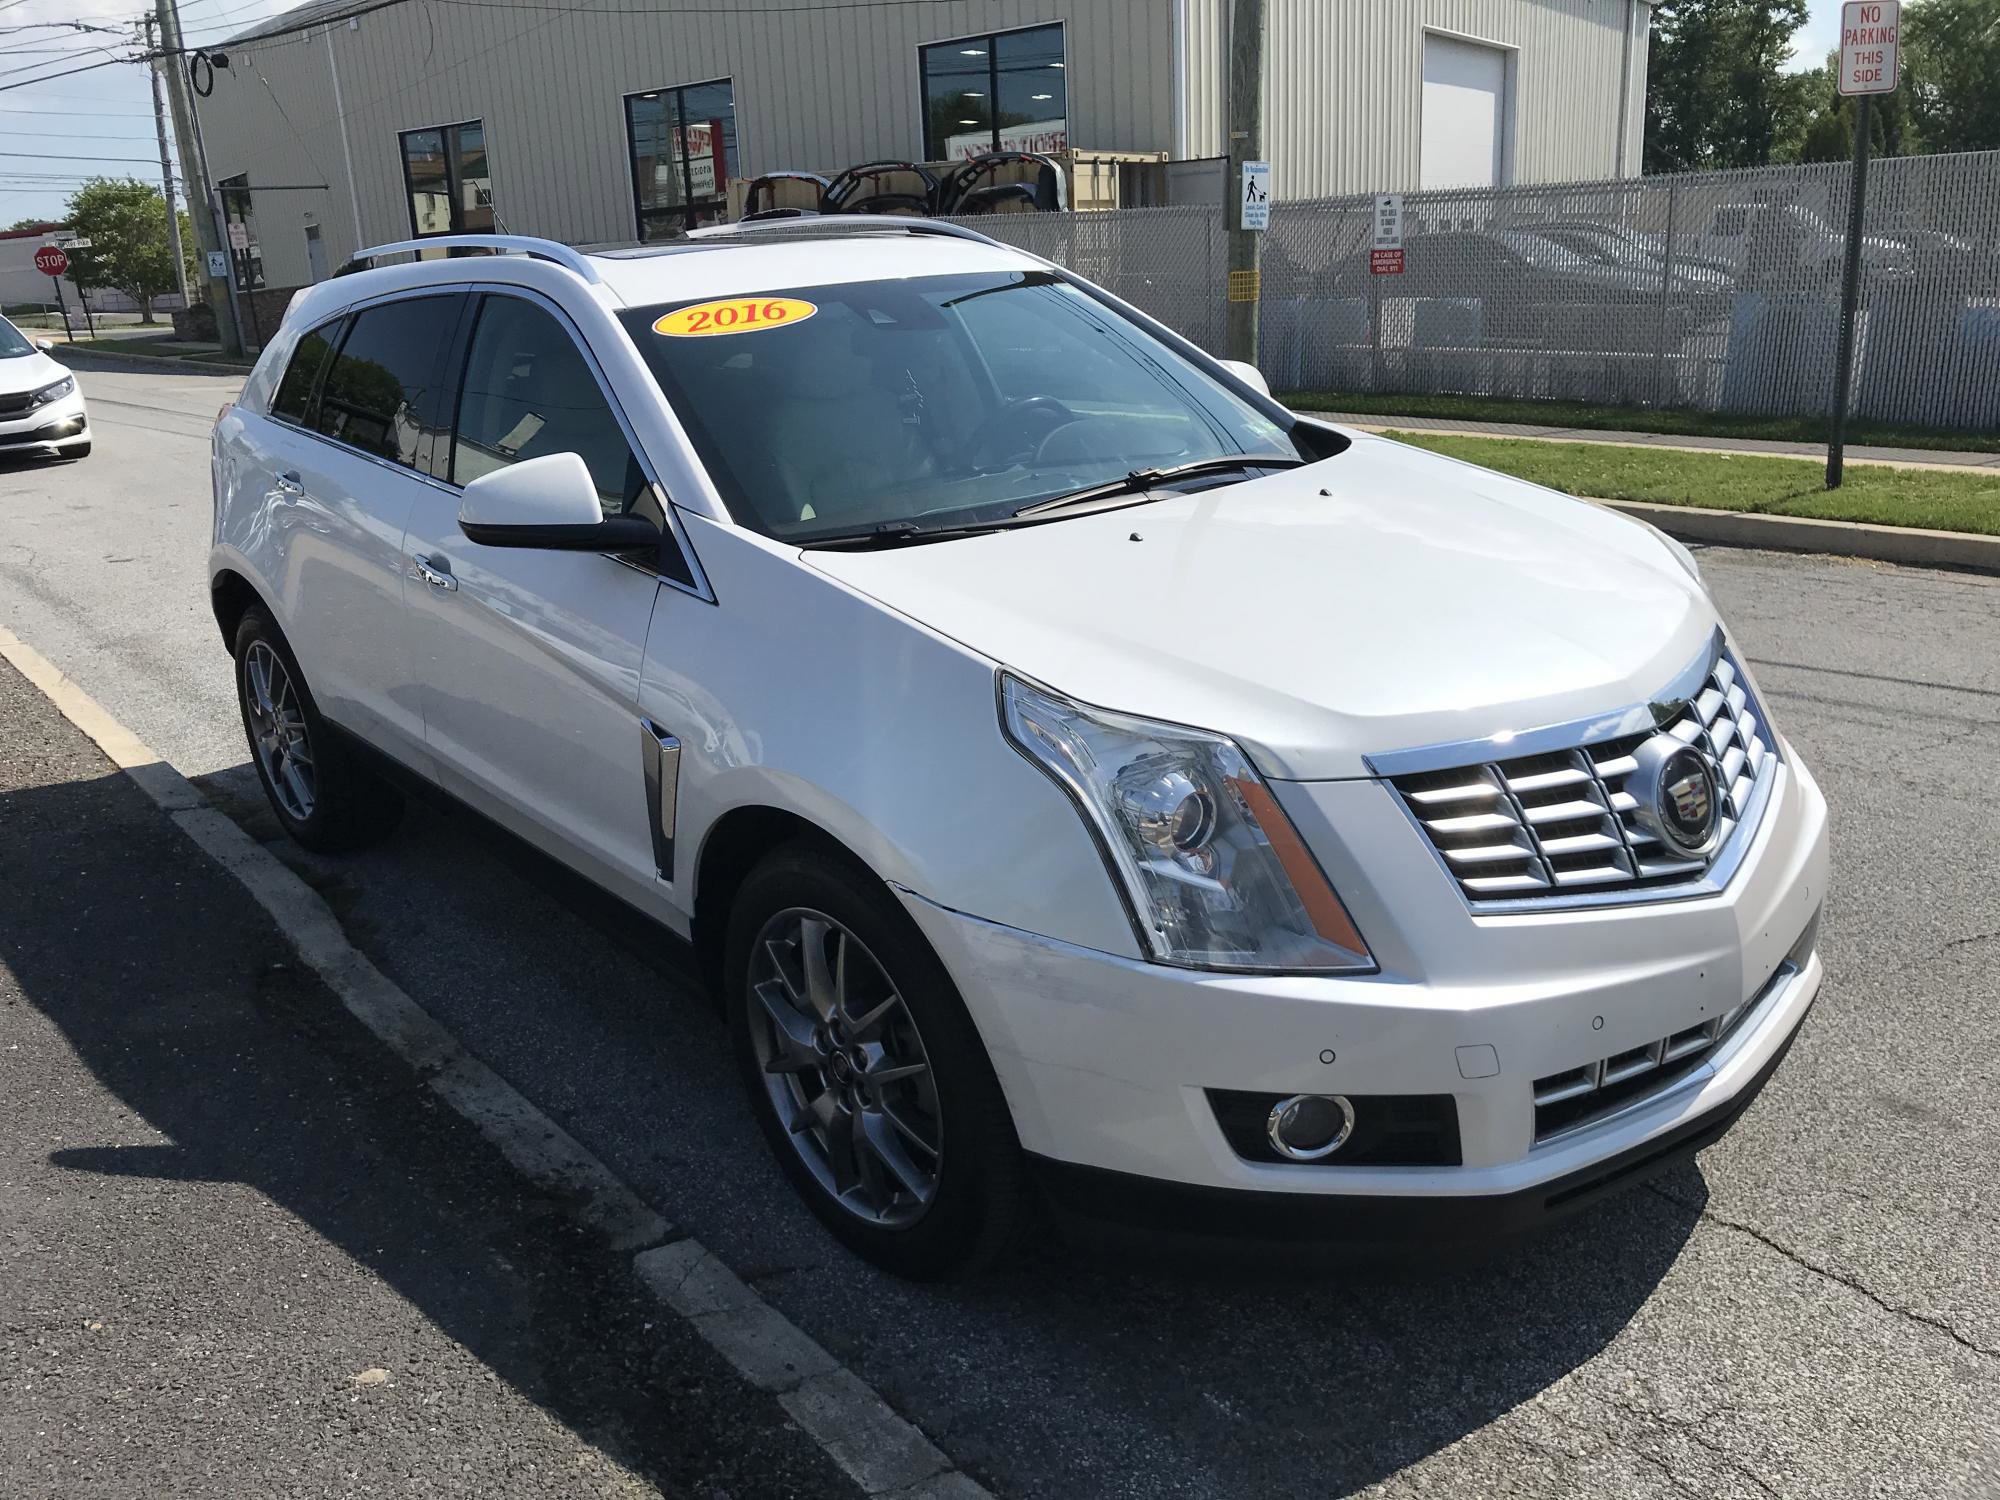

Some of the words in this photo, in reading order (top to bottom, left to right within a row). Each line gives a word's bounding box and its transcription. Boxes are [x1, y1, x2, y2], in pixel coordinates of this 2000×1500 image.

[1860, 6, 1881, 24] NO
[1844, 26, 1895, 46] PARKING
[1854, 51, 1884, 65] THIS
[1853, 68, 1883, 83] SIDE
[36, 254, 65, 268] STOP
[687, 300, 787, 332] 2016
